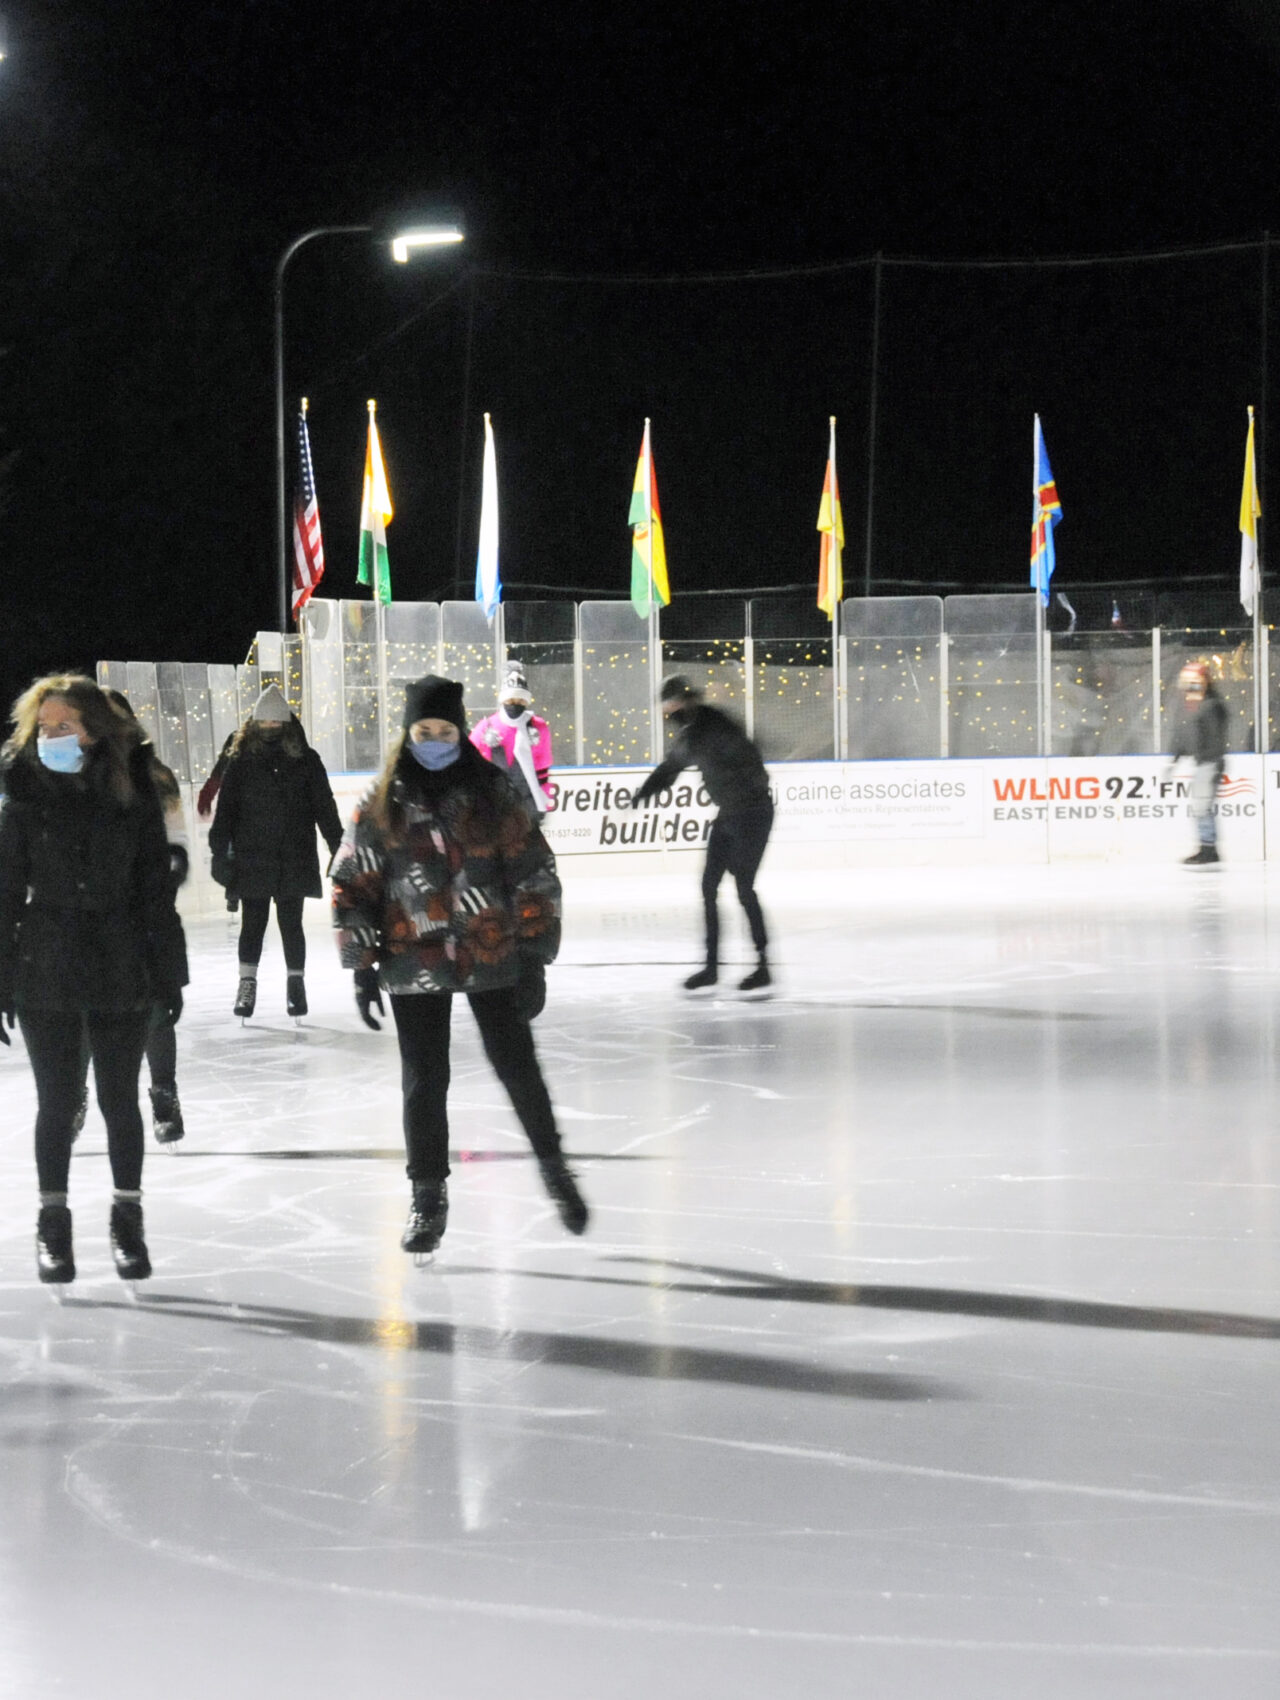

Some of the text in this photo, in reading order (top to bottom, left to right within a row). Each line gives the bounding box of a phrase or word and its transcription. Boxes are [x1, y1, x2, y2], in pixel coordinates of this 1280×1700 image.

[786, 782, 842, 801] caine
[850, 779, 966, 800] associates
[993, 777, 1100, 801] WLNG
[993, 807, 1048, 820] EAST
[1055, 805, 1115, 819] END'S
[1123, 805, 1178, 818] BEST
